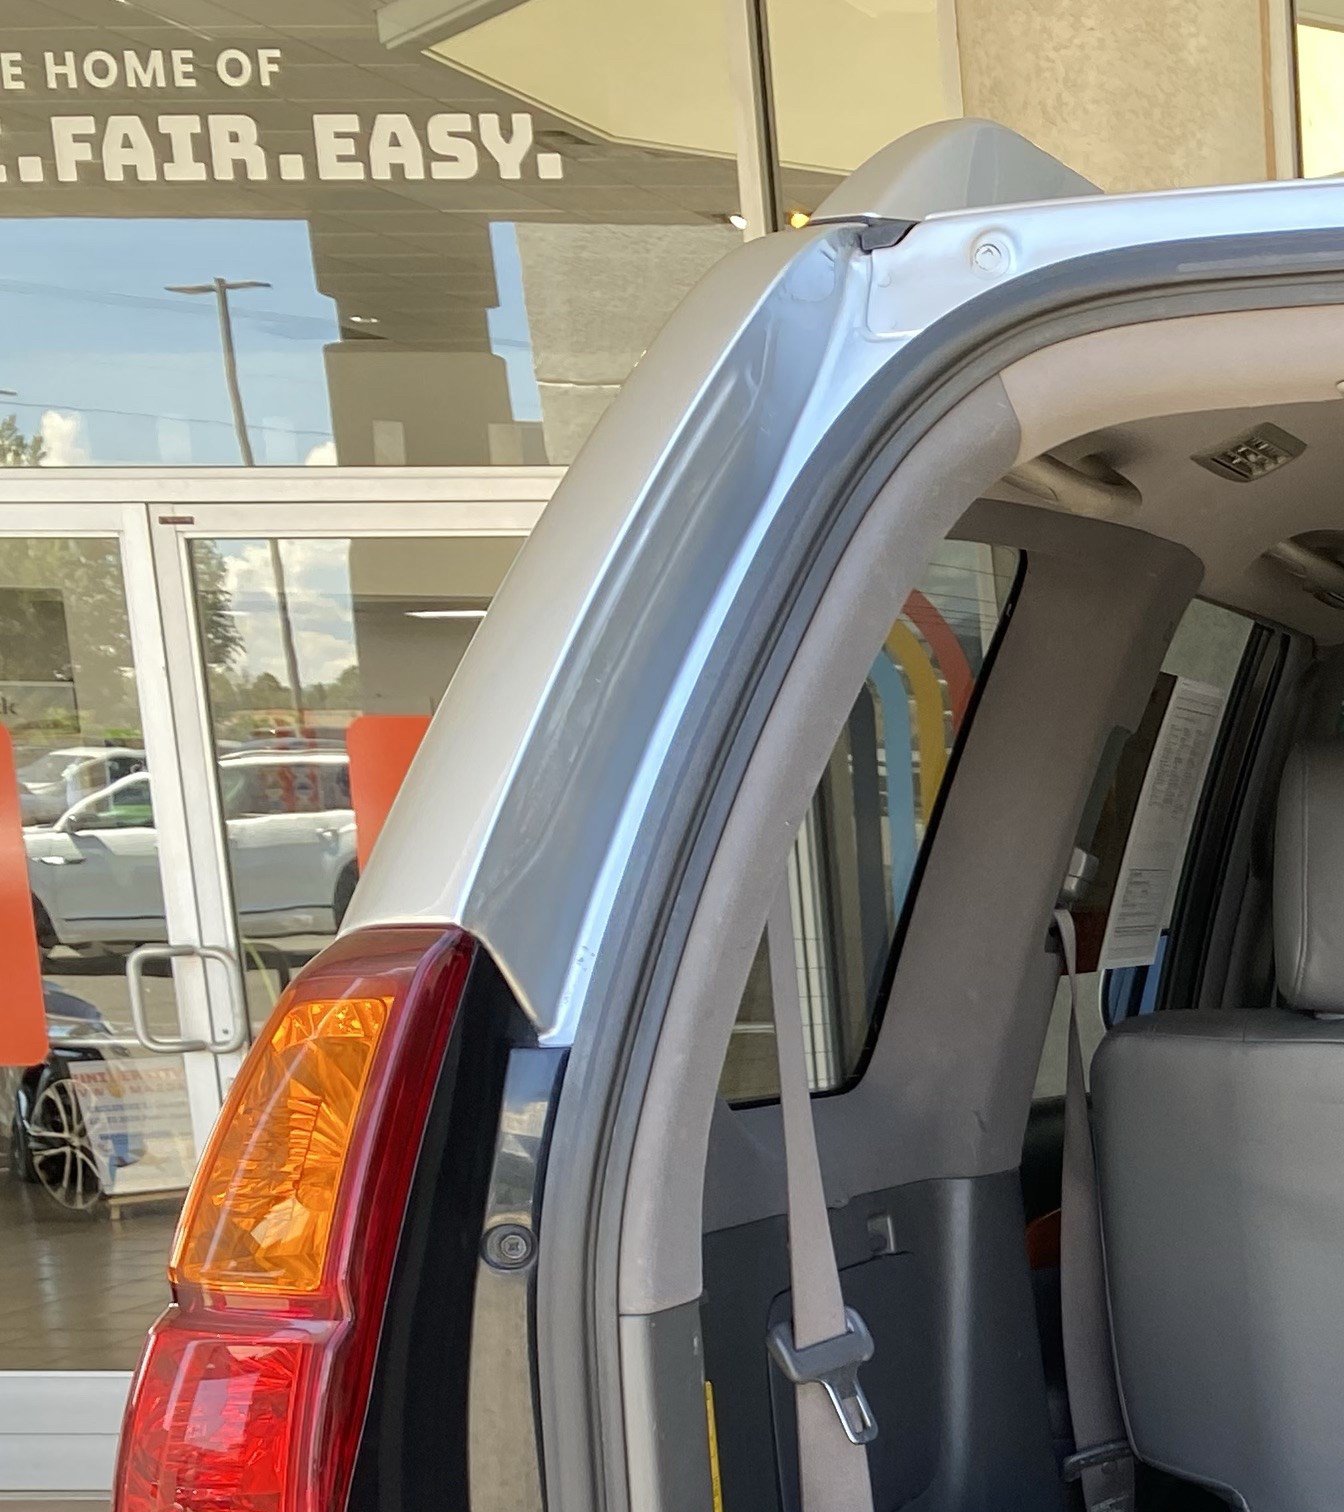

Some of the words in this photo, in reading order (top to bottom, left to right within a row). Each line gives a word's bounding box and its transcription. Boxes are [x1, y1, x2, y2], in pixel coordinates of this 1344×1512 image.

[44, 49, 197, 89] HOME
[216, 48, 282, 87] OF
[0, 113, 564, 183] .FAIR.EASY.
